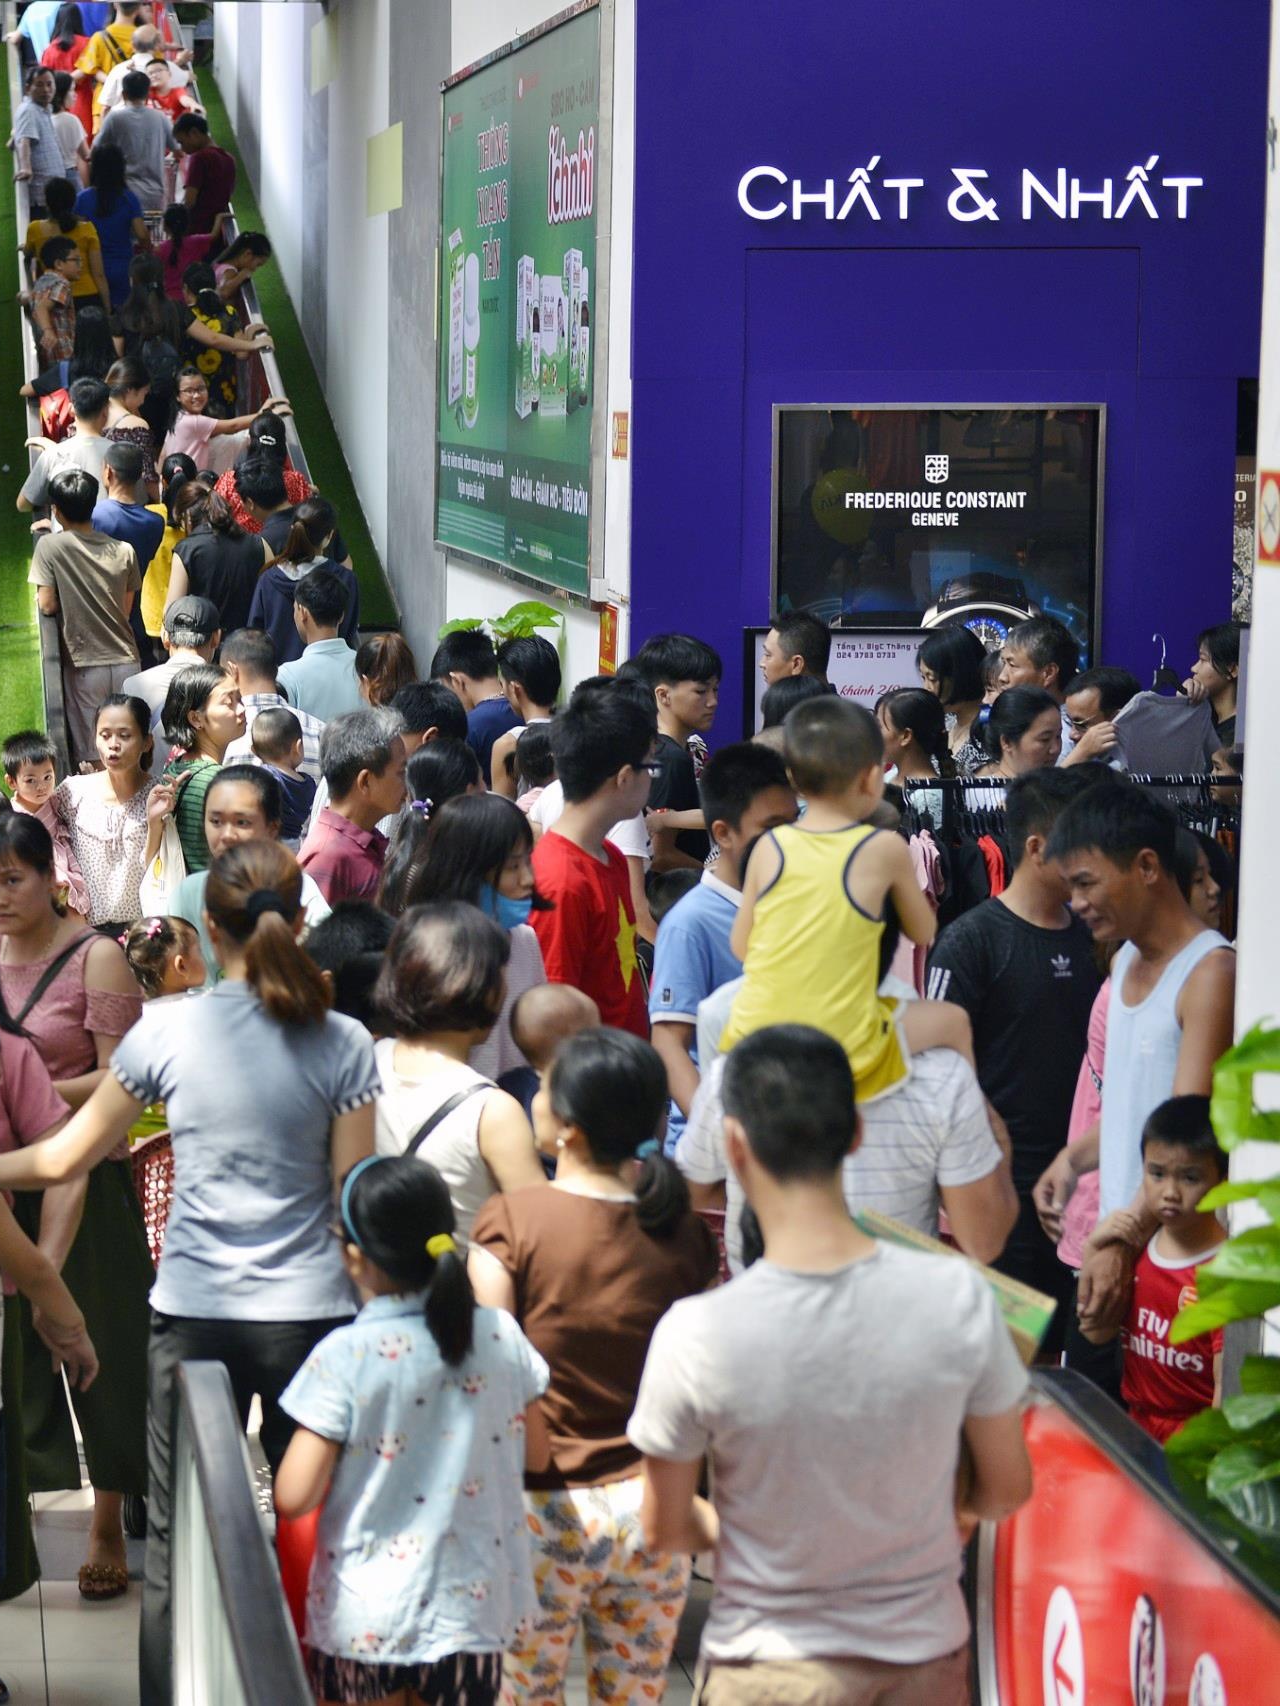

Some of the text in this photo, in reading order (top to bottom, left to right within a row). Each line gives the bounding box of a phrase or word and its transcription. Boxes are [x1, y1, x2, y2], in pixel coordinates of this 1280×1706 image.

[946, 167, 1001, 222] &
[549, 483, 559, 510] HO
[845, 491, 1027, 509] FREDERIQUE CONSTANT
[911, 512, 959, 527] GENEVE
[839, 684, 875, 696] khánh
[1137, 1306, 1170, 1340] Fly
